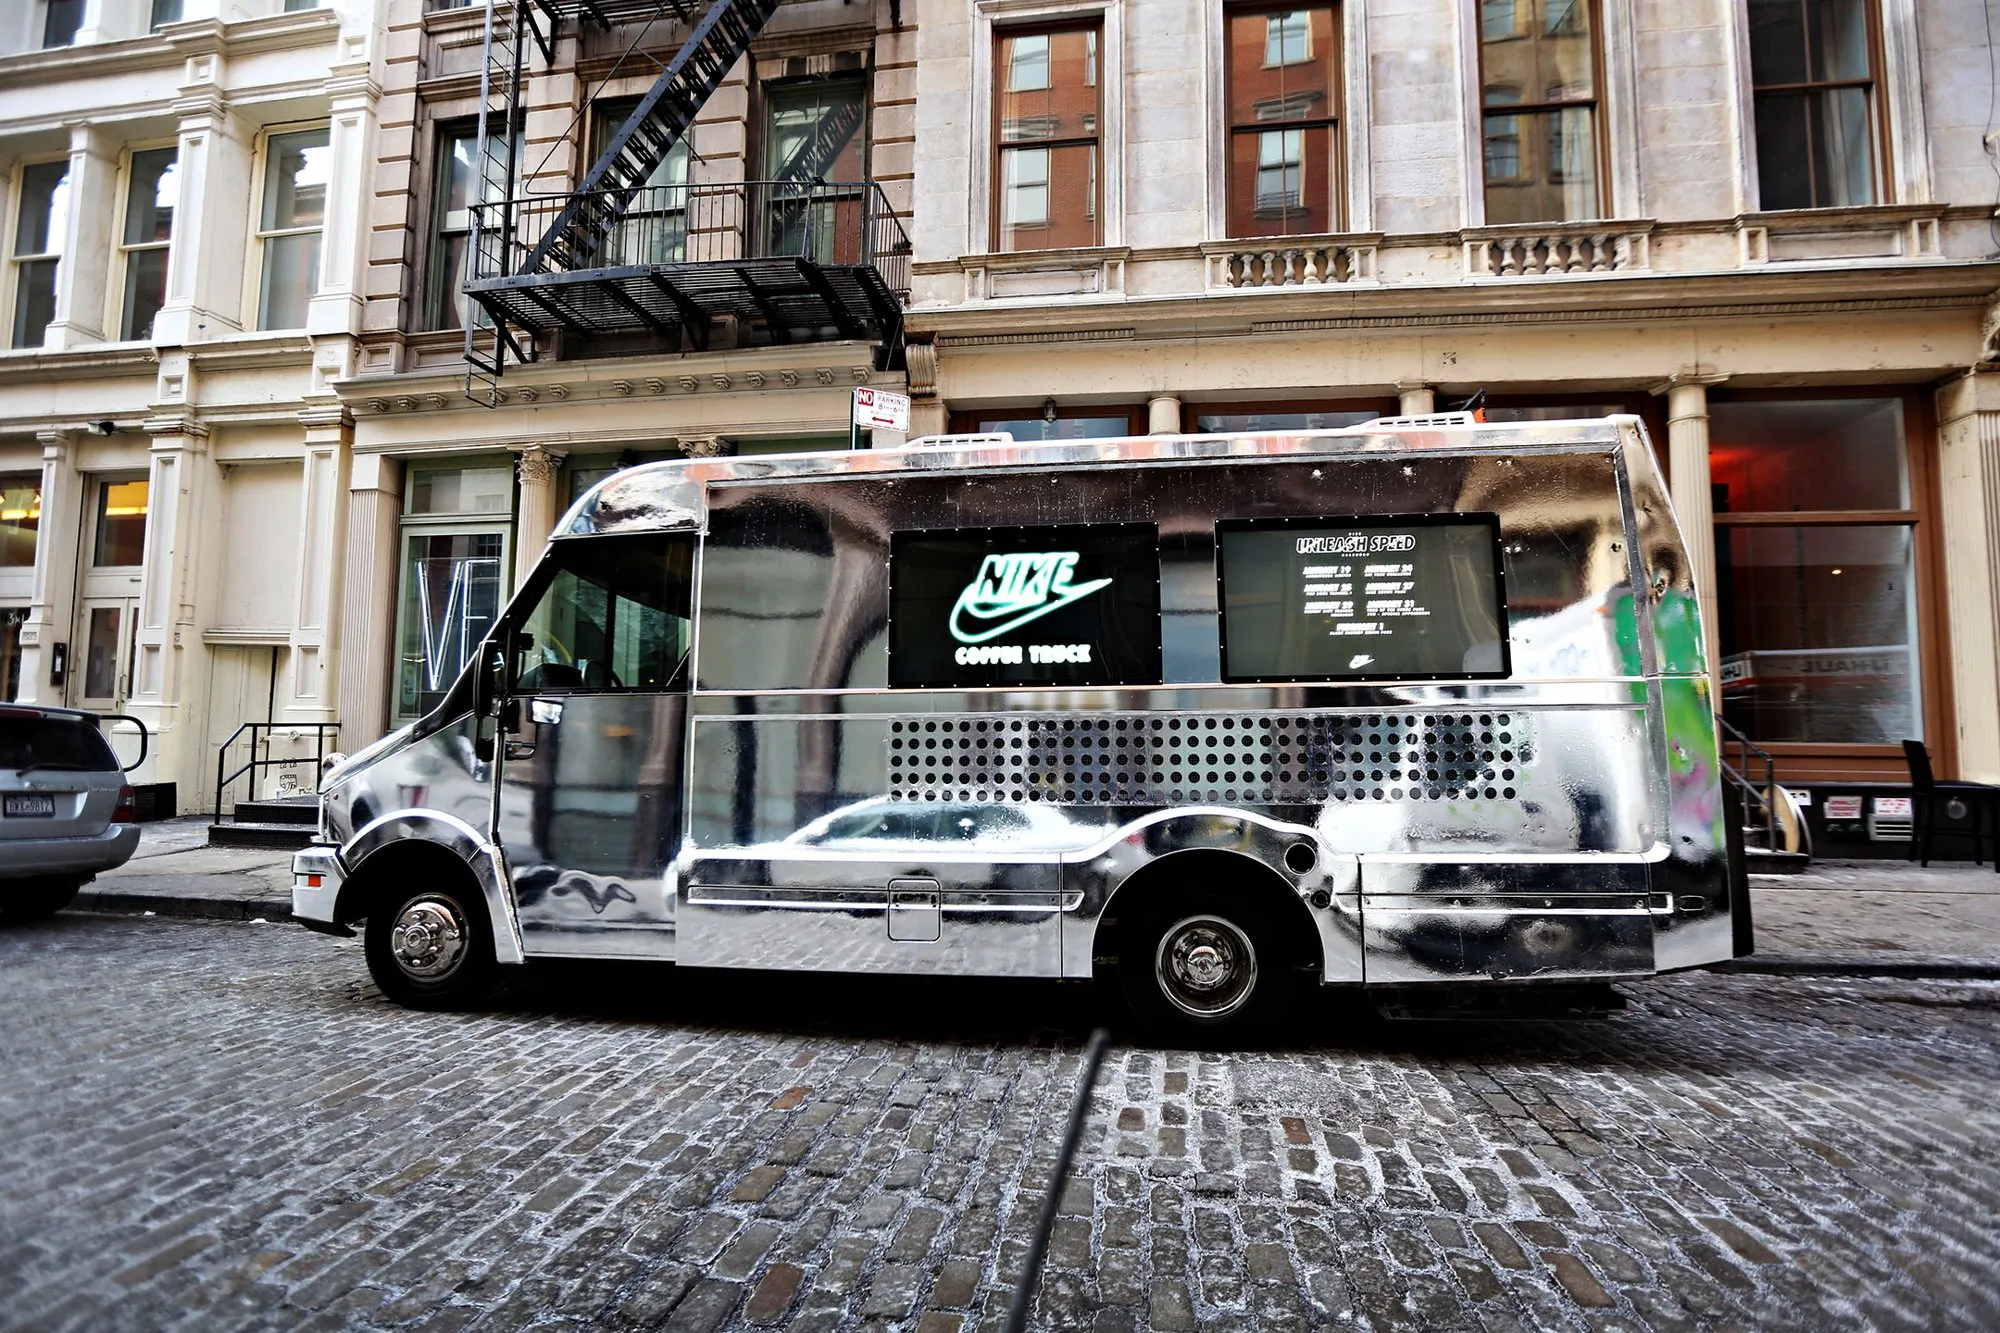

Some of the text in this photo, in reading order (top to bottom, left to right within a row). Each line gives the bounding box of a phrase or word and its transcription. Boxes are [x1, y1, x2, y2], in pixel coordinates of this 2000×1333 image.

[859, 389, 906, 407] NO PARKING
[1296, 533, 1416, 554] UNLEASH SPEED
[975, 551, 1080, 604] NIKE
[955, 644, 1092, 666] COFFEE TRUCK
